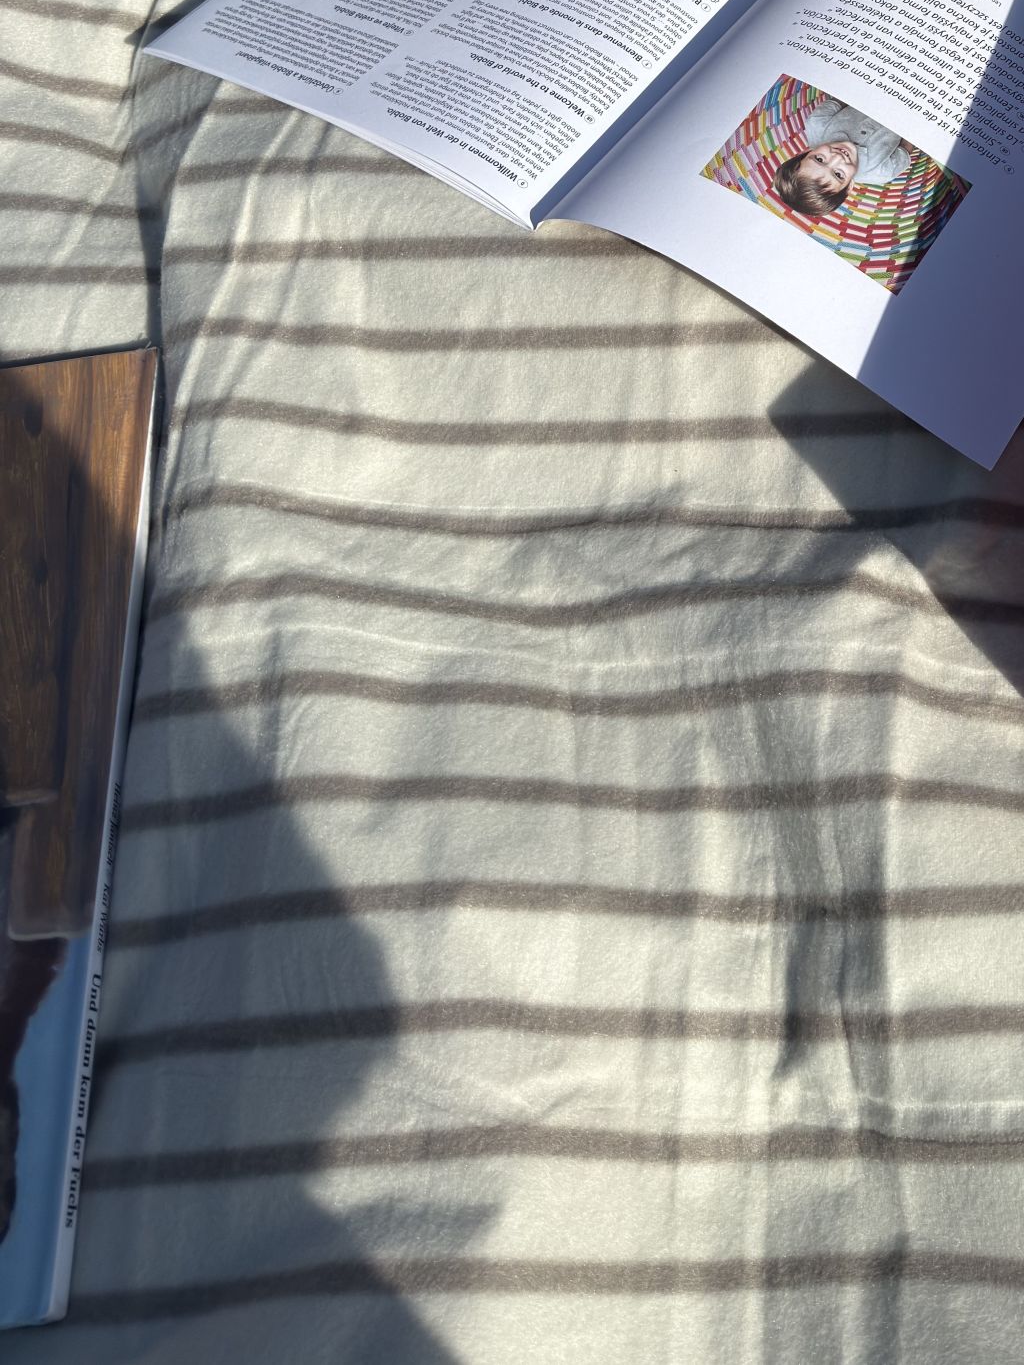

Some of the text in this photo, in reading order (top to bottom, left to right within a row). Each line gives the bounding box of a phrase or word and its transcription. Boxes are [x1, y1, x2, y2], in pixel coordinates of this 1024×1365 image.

[547, 8, 576, 23] monde
[897, 7, 927, 27] forma
[945, 7, 980, 30] končna
[582, 23, 603, 36] dans
[875, 23, 893, 36] van
[930, 11, 973, 40] najvyššia
[988, 17, 1007, 33] jest
[893, 33, 918, 50] vorm
[901, 23, 940, 48] formája
[601, 32, 643, 62] Bienvenue
[872, 35, 917, 64] definitiva
[937, 43, 966, 65] végső
[467, 52, 495, 67] Bioblo.
[829, 56, 850, 70] der
[863, 59, 889, 77] form
[869, 47, 911, 74] suprême
[917, 46, 953, 72] ultieme
[501, 66, 526, 80] world
[849, 66, 876, 85] Form
[915, 59, 946, 82] forma
[524, 77, 540, 88] the
[887, 72, 927, 101] ultimate
[909, 70, 939, 93] forme
[548, 89, 586, 117] Welcome
[874, 80, 922, 113] ultimative
[926, 96, 943, 111] the
[947, 94, 963, 108] est
[972, 79, 1019, 114] „Eenvoud
[384, 106, 412, 122] Bioblo.
[432, 115, 446, 123] wie
[921, 108, 938, 123] die
[964, 90, 1017, 130] simplicidad
[410, 117, 427, 127] von
[443, 120, 465, 133] immer
[936, 118, 950, 132] ist
[961, 103, 1005, 137] simplicité
[424, 124, 445, 137] Welt
[442, 133, 460, 144] der
[951, 111, 1002, 149] „Simplicity
[463, 130, 496, 150] Bausteine
[948, 125, 1006, 167] „Einfachheit
[1005, 131, 1024, 148] „La
[493, 147, 510, 159] dass
[508, 155, 526, 169] sagt,
[466, 145, 518, 181] Willkommen
[523, 167, 538, 180] Wer
[65, 974, 102, 1229] Und dann kam der Fuchs
